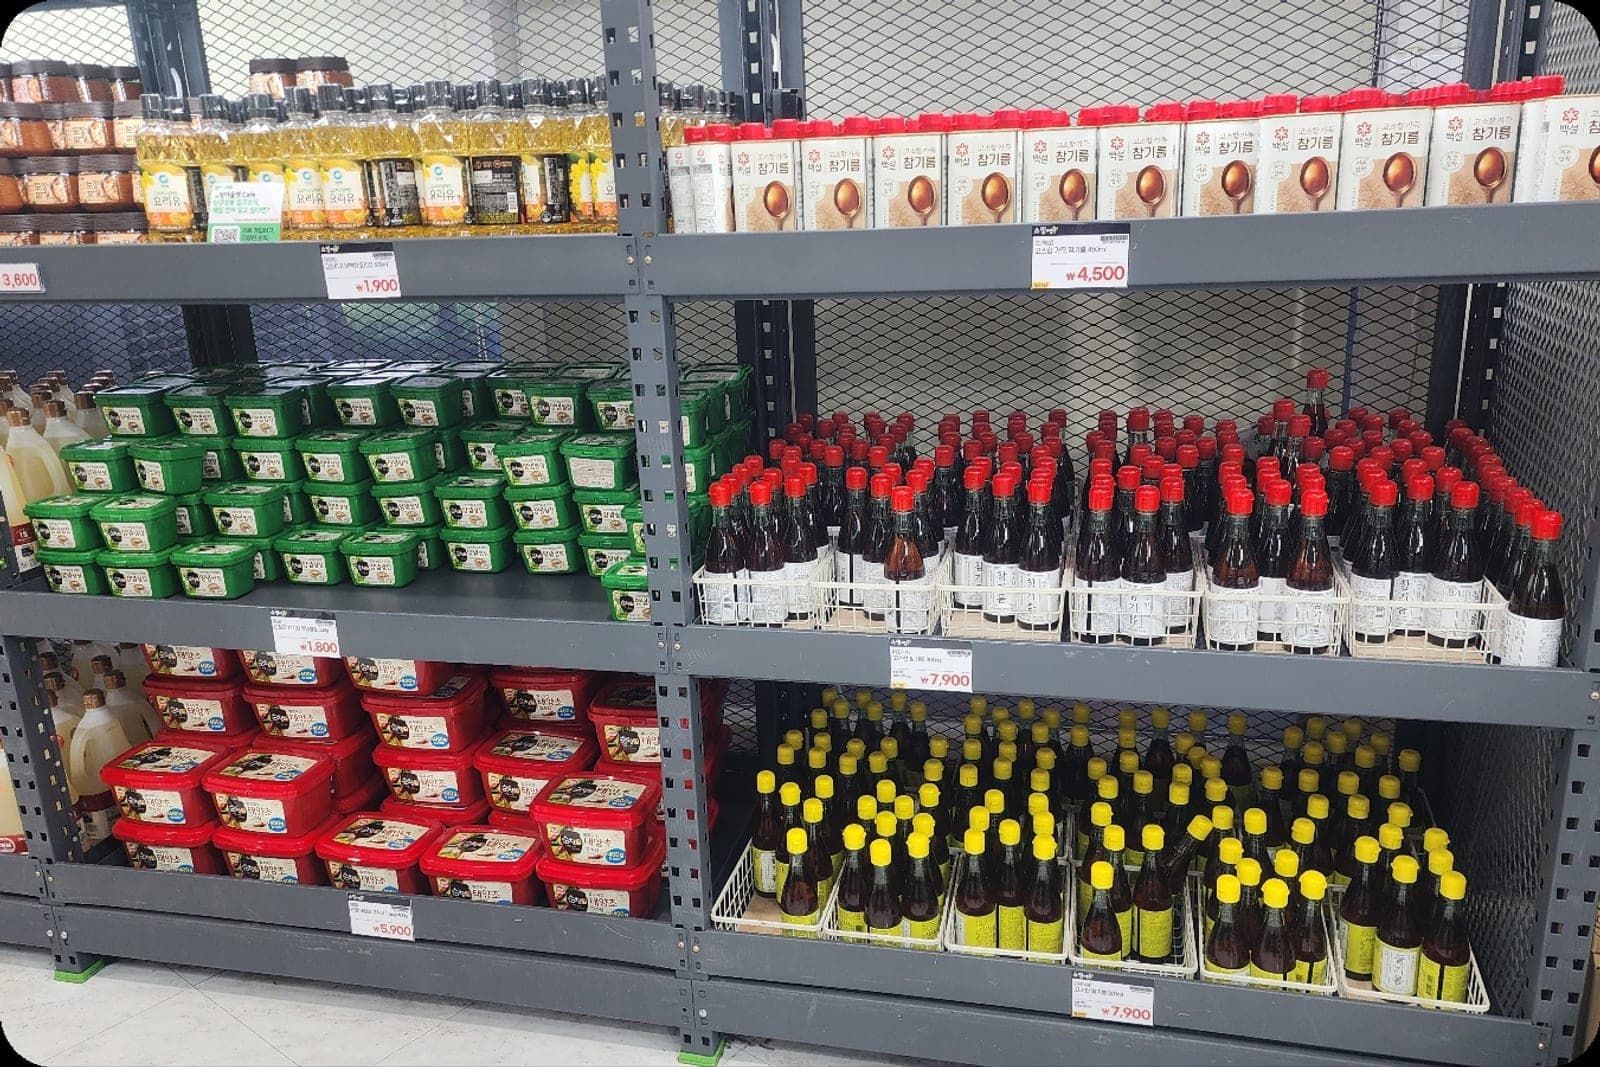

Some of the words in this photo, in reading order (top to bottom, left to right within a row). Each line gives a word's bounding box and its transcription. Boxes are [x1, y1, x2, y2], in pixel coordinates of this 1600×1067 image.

[1382, 131, 1419, 145] 참기름
[1473, 126, 1511, 140] 참기름
[1218, 142, 1252, 154] 참기름
[1298, 137, 1332, 150] 참기름
[978, 153, 1011, 166] 참기름
[1056, 150, 1089, 163] 참기름
[1133, 146, 1166, 160] 참기름
[758, 162, 789, 175] 참기름
[829, 158, 860, 172] 참기름
[904, 156, 936, 170] 참기름
[430, 190, 456, 201] 요리유
